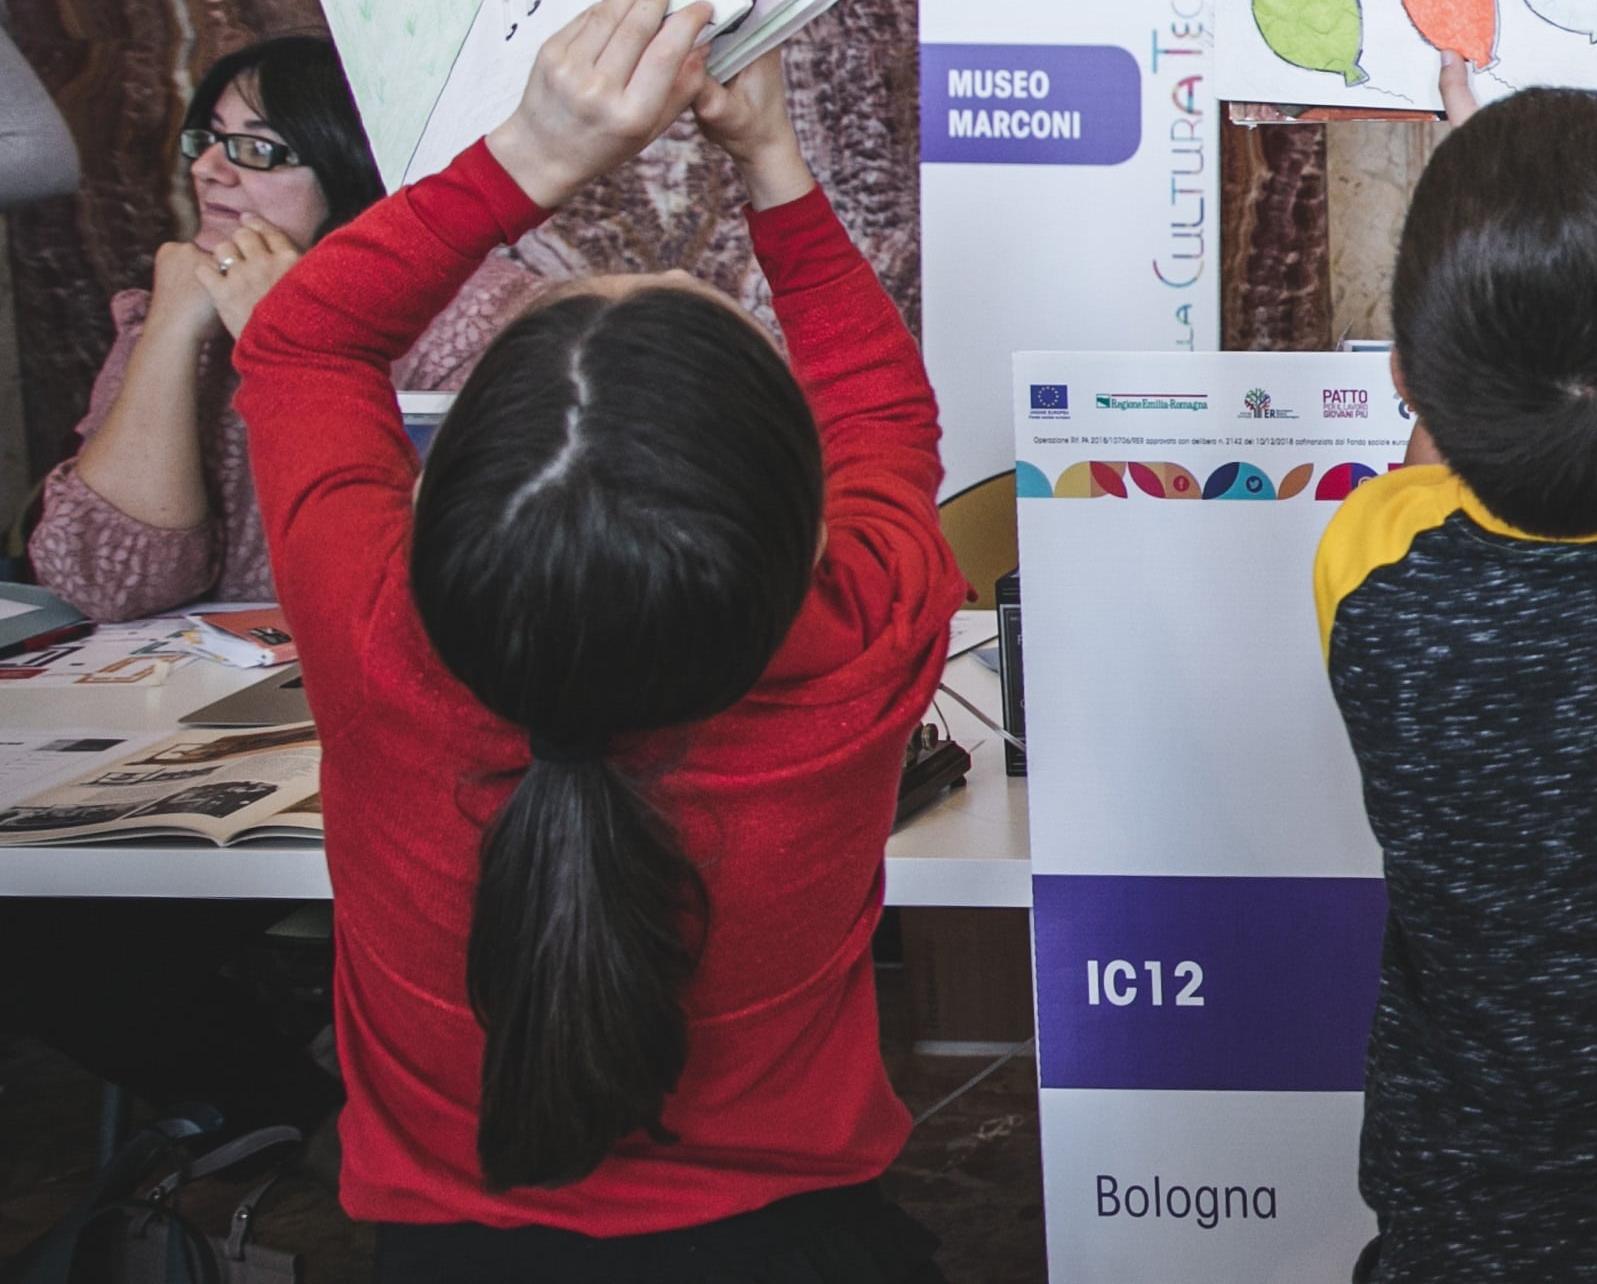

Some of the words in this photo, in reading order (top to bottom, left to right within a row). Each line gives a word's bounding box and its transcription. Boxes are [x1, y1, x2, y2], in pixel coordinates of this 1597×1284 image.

[948, 70, 1050, 99] MUSEO
[948, 109, 1081, 140] MARCONI
[1323, 389, 1368, 404] PATTO
[1264, 409, 1276, 418] ER
[1087, 959, 1205, 1006] IC12
[1096, 1174, 1277, 1230] Bologna
